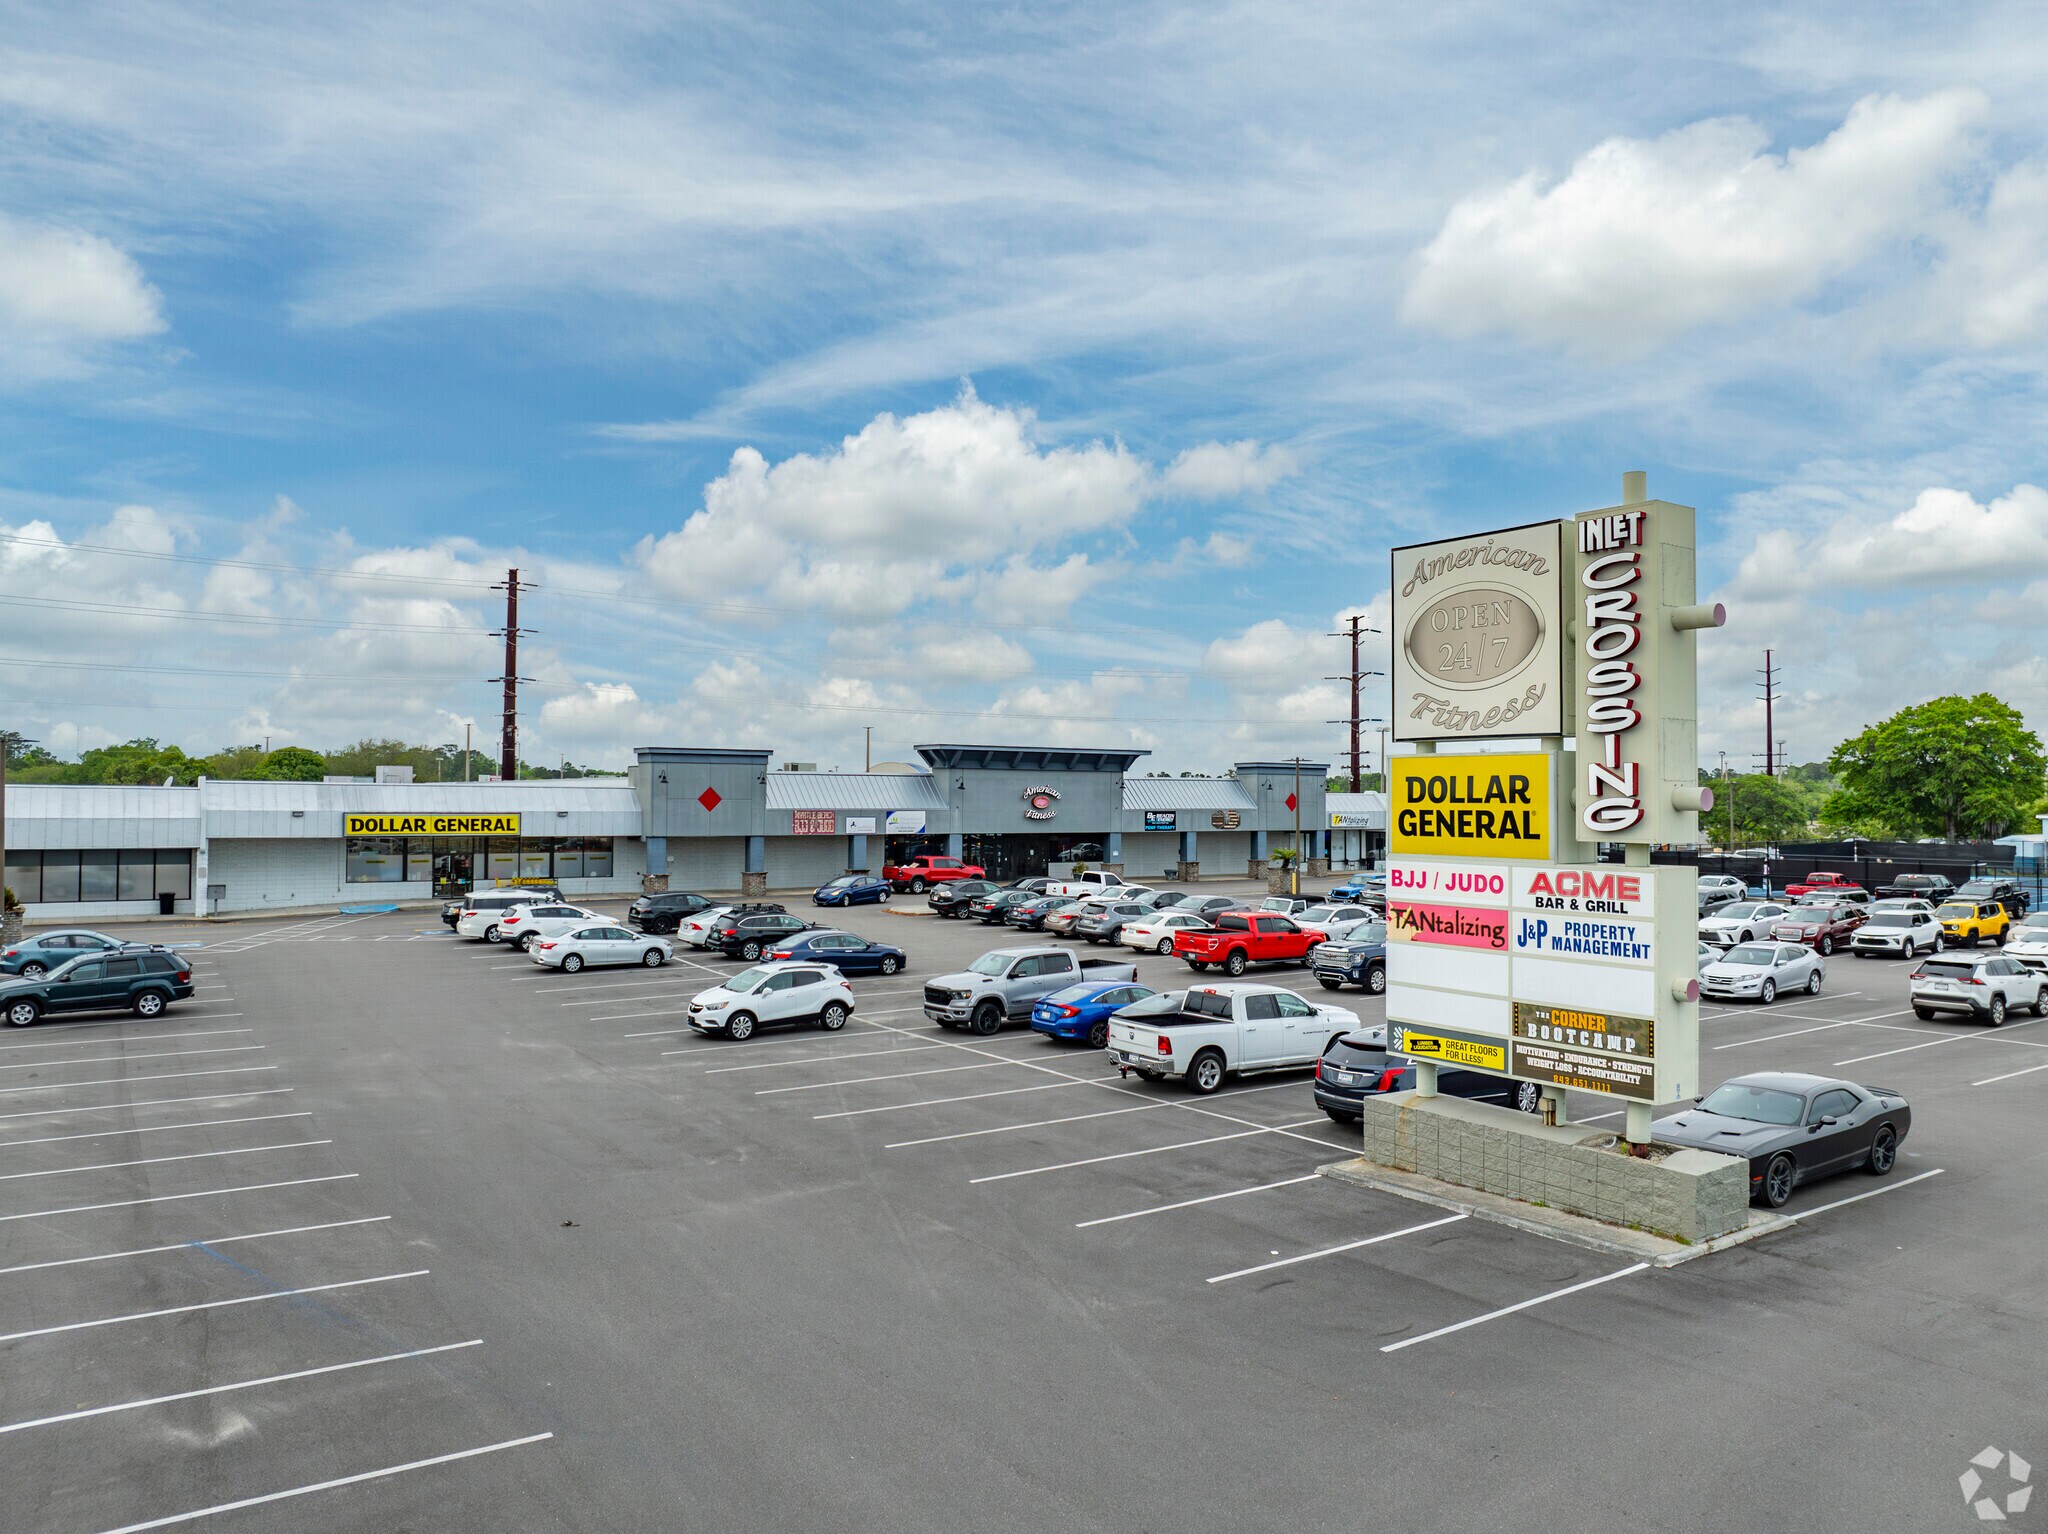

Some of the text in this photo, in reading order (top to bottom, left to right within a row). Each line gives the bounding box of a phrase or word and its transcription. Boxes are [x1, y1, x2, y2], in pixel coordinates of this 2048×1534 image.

[1578, 511, 1645, 553] INLET
[1402, 538, 1550, 597] American
[1431, 599, 1512, 632] OPEN
[1438, 633, 1510, 676] 24/7
[1581, 552, 1644, 832] CROSSING
[1410, 683, 1546, 731] Fitness
[1023, 785, 1062, 800] American
[1405, 775, 1531, 804] DOLLAR
[350, 818, 515, 832] DOLLAR GENERAL
[1025, 809, 1057, 820] Fitness
[1391, 869, 1427, 889] BJJ
[1445, 872, 1504, 894] JUDO
[1528, 871, 1641, 902] ACME
[1535, 896, 1628, 914] BAR & GRILL
[1390, 908, 1505, 948] TANtalizing
[1517, 918, 1548, 949] J&P
[1564, 922, 1636, 941] PROPERTY
[1552, 936, 1651, 960] MANAGEMENT
[1535, 1009, 1607, 1033] THE CORNER
[1445, 1040, 1498, 1057] GREAT FLOORS
[1527, 1022, 1636, 1053] BOOTCAMP
[1445, 1050, 1484, 1064] FOR LLESS!
[1515, 1044, 1653, 1076] MOTIVATION ENDURANCE STRENGTH
[1526, 1056, 1641, 1085] WEIGHT LOSS ACCOUNTABILITY
[1553, 1074, 1611, 1093] 843.651.1111
